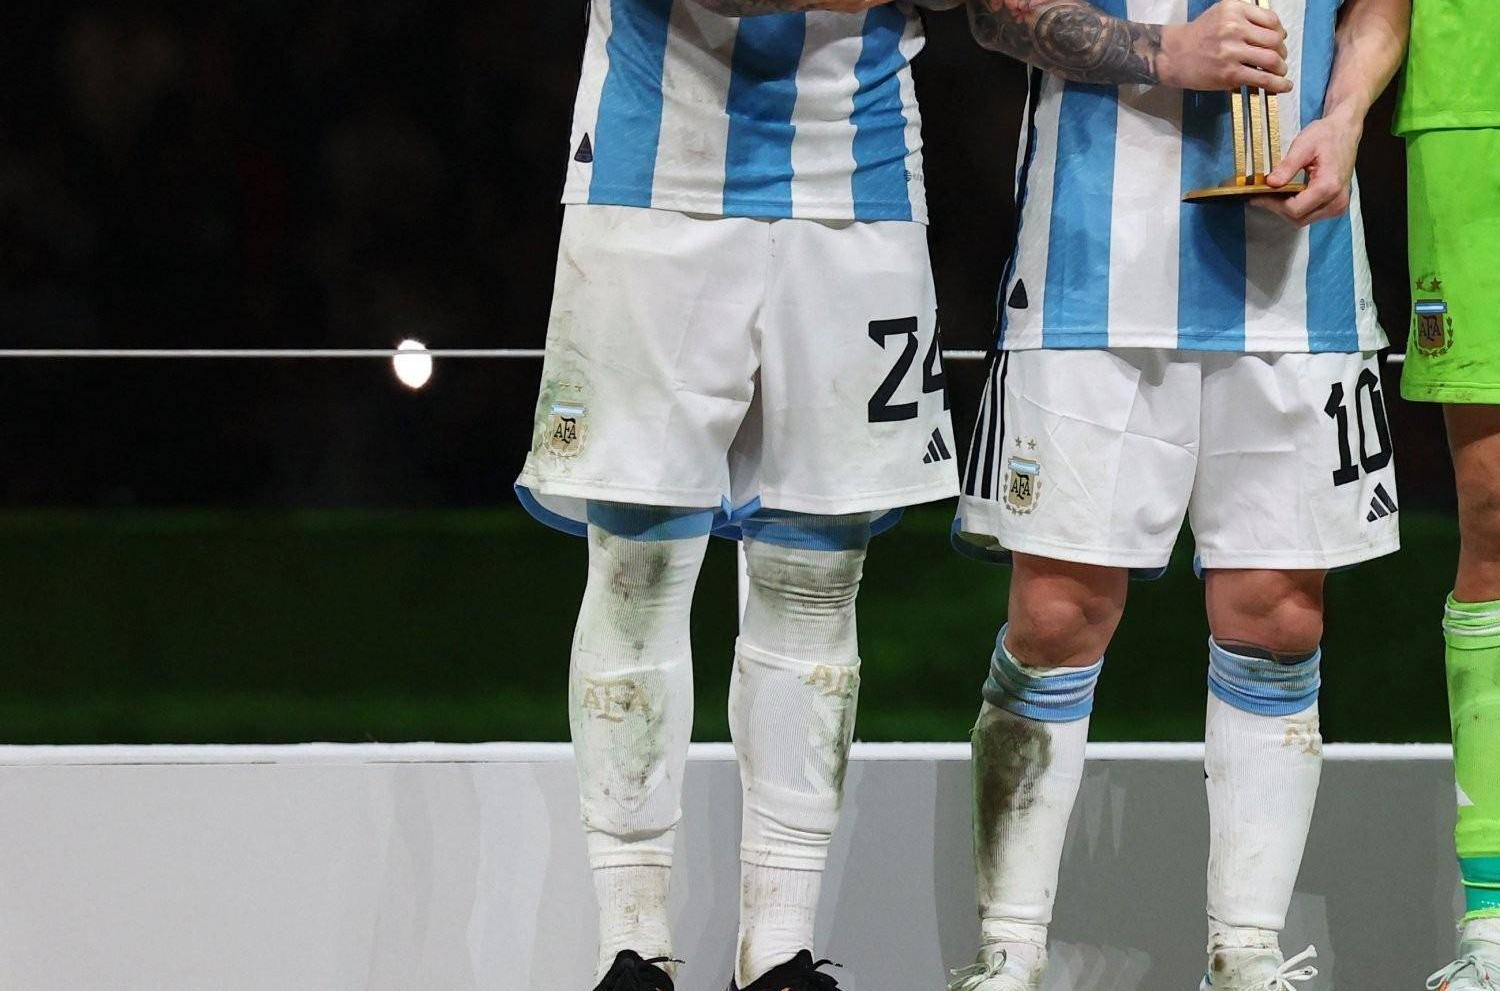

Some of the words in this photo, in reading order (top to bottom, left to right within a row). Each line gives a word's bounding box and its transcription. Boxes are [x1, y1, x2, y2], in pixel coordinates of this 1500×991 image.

[868, 309, 951, 423] 24
[553, 416, 577, 444] AFA
[1324, 367, 1393, 487] 10
[1011, 472, 1031, 500] AFA
